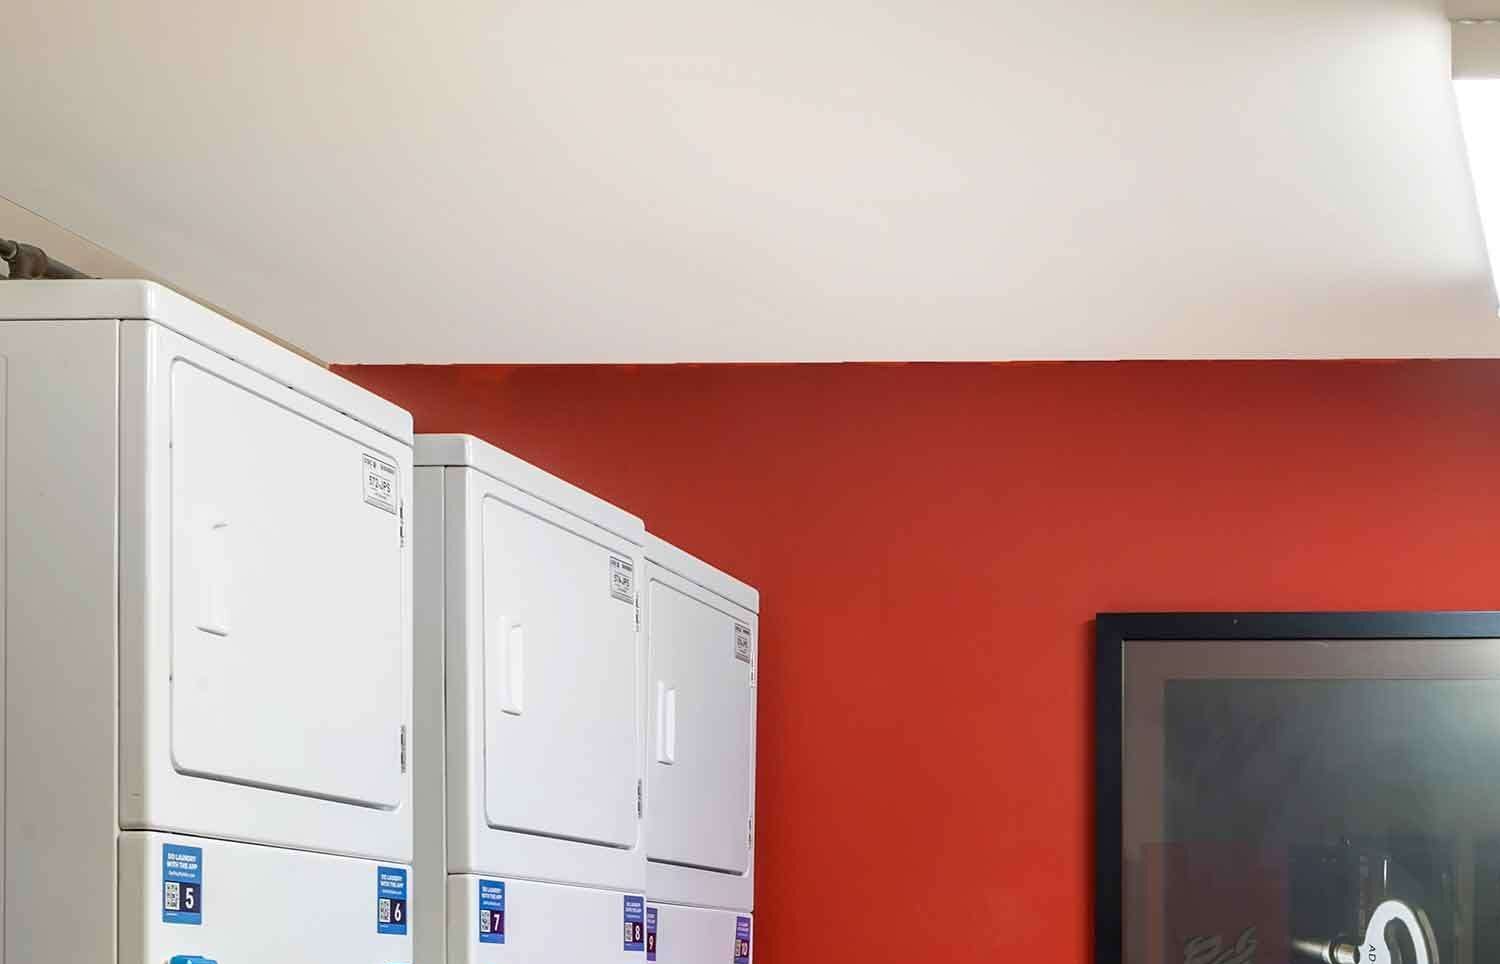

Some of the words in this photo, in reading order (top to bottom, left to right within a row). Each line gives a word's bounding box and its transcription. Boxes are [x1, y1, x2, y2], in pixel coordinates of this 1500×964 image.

[185, 887, 194, 909] 5
[394, 903, 402, 922] 6
[493, 913, 500, 932] 7
[634, 925, 641, 941] 8
[648, 935, 654, 951] 9
